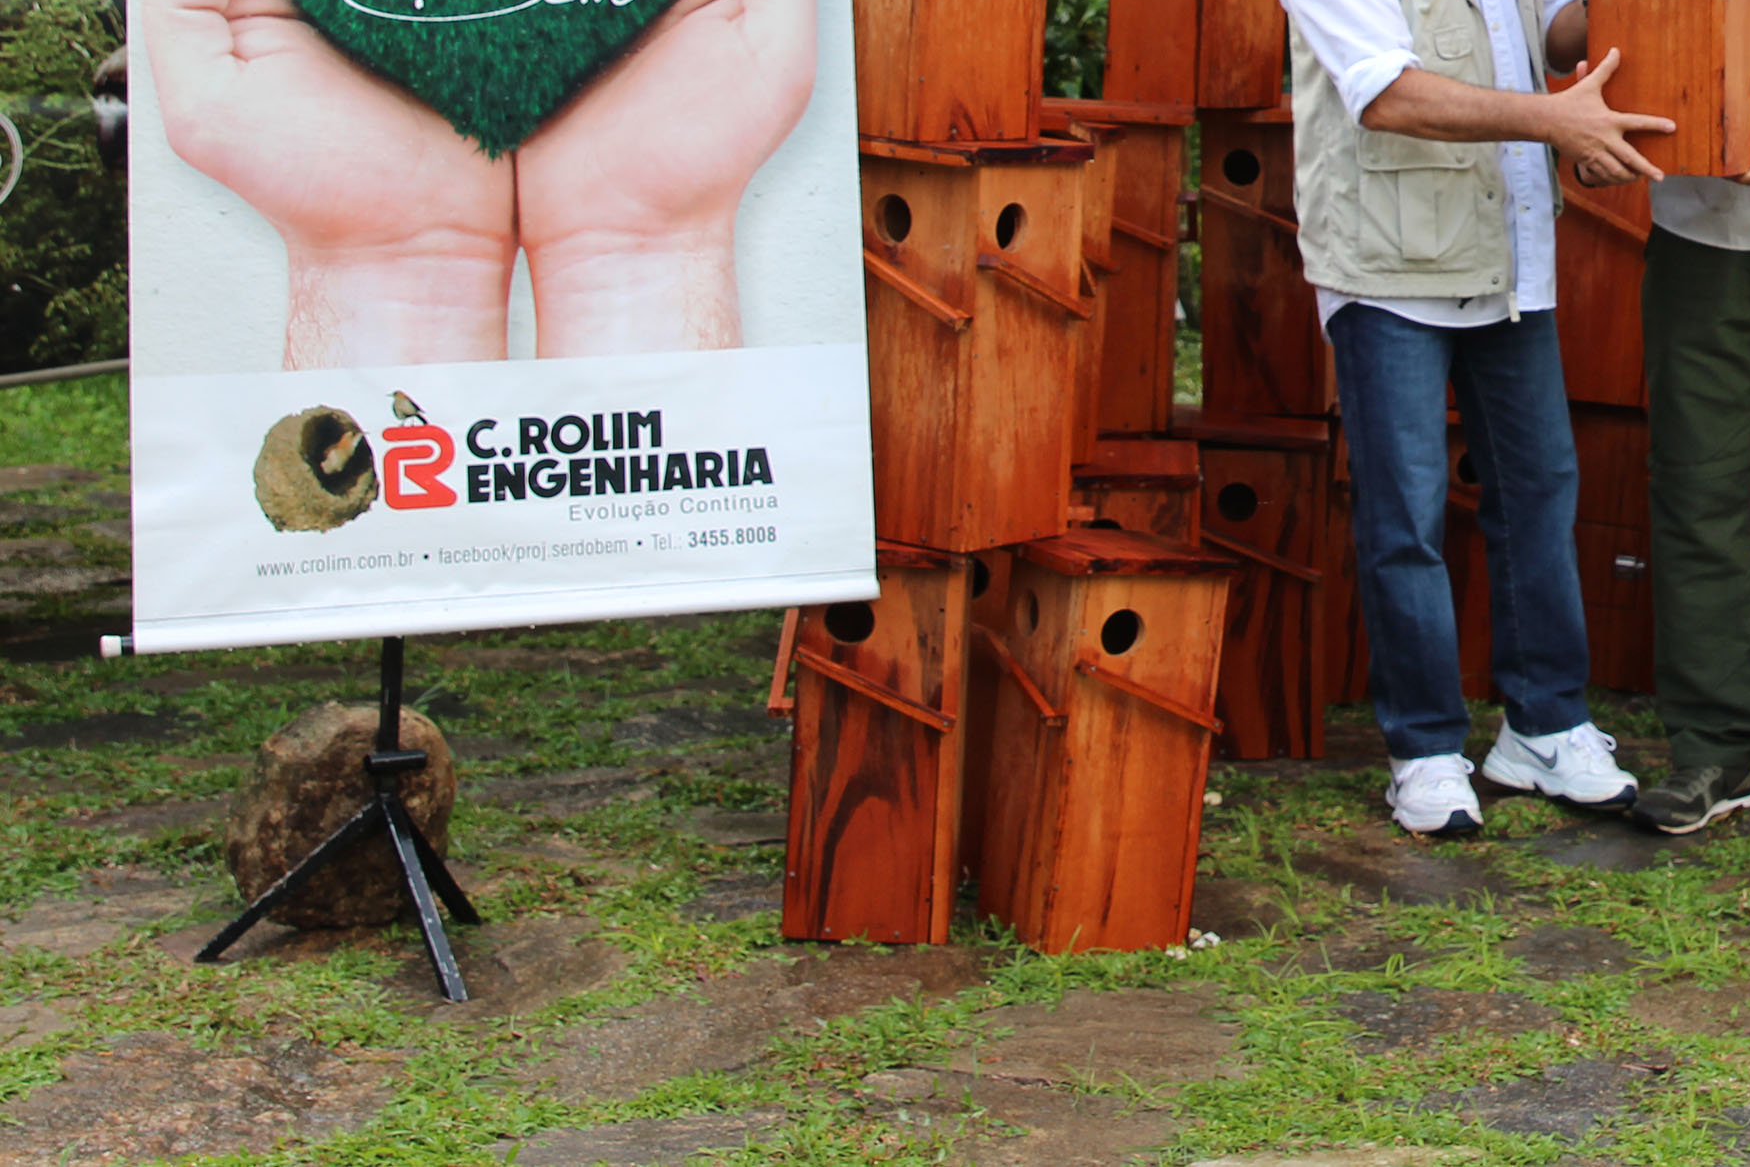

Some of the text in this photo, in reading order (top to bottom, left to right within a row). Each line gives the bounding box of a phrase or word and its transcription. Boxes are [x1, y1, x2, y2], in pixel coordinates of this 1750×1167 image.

[466, 446, 774, 504] ENGENHARIA
[568, 500, 671, 522] Evolução
[256, 550, 415, 577] www.crolim.com.br
[438, 538, 629, 565] facebook/proj.serdobem
[688, 525, 777, 549] 3455.8008
